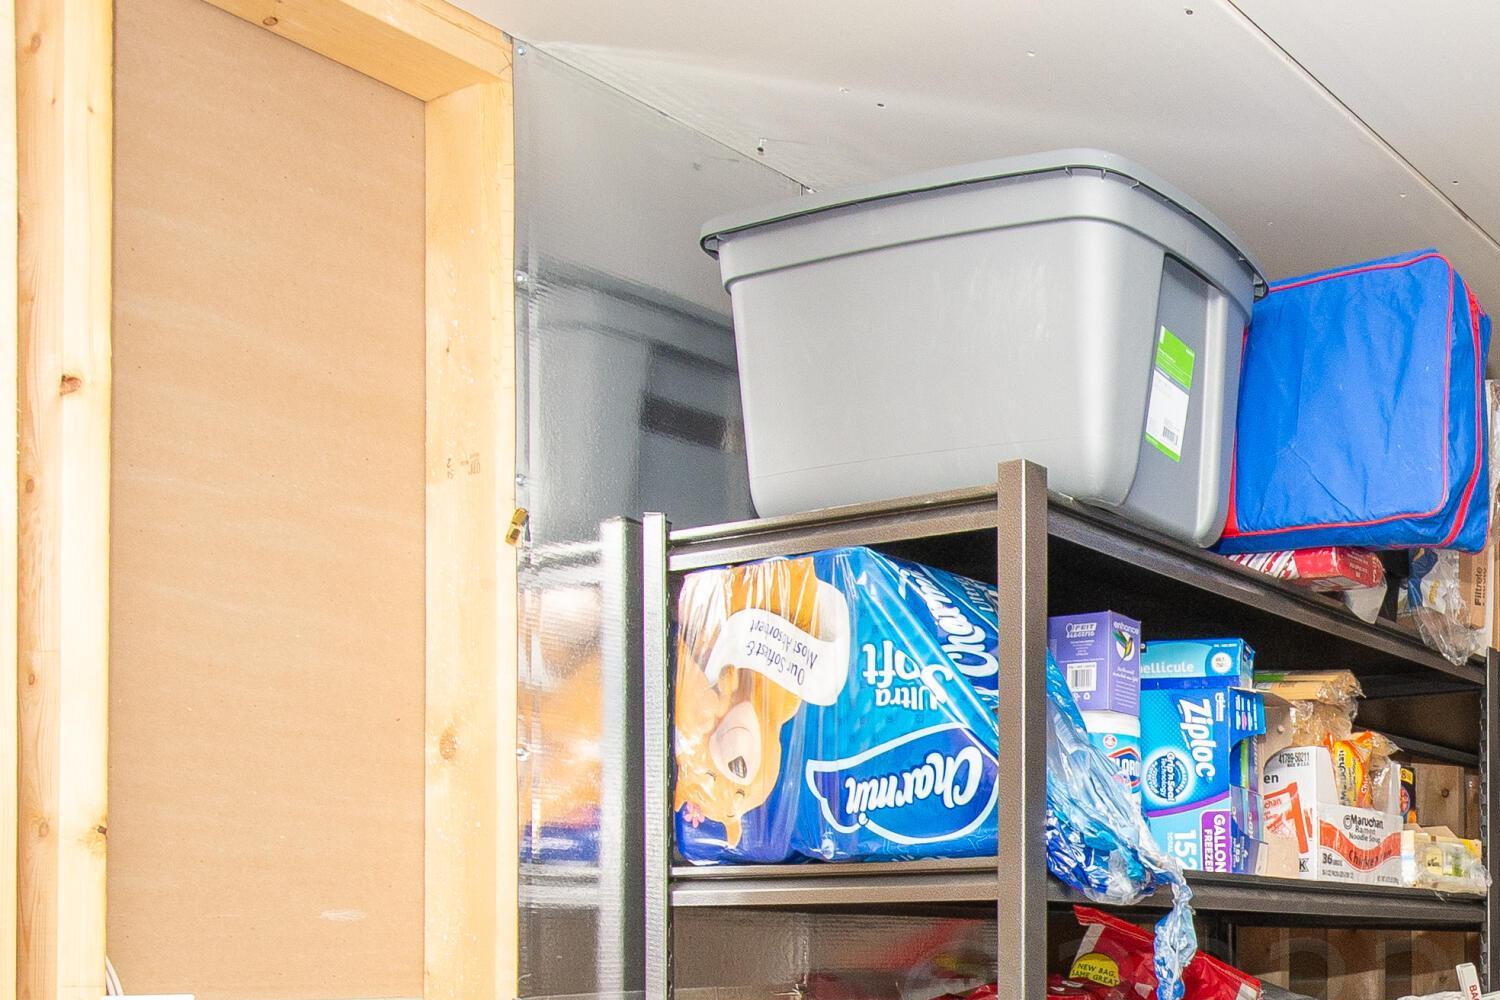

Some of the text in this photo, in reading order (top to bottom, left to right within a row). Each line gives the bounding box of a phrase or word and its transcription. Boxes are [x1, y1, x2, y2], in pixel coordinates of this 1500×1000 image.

[862, 640, 954, 704] Soft
[875, 686, 939, 711] Ultra
[1178, 698, 1217, 777] Ziploc
[844, 745, 983, 826] Charmin
[1351, 814, 1384, 829] Maruchan
[1213, 814, 1227, 872] GALLON
[1322, 853, 1333, 864] 36
[1072, 969, 1121, 987] SAME GREAT
[1076, 962, 1096, 973] NEW
